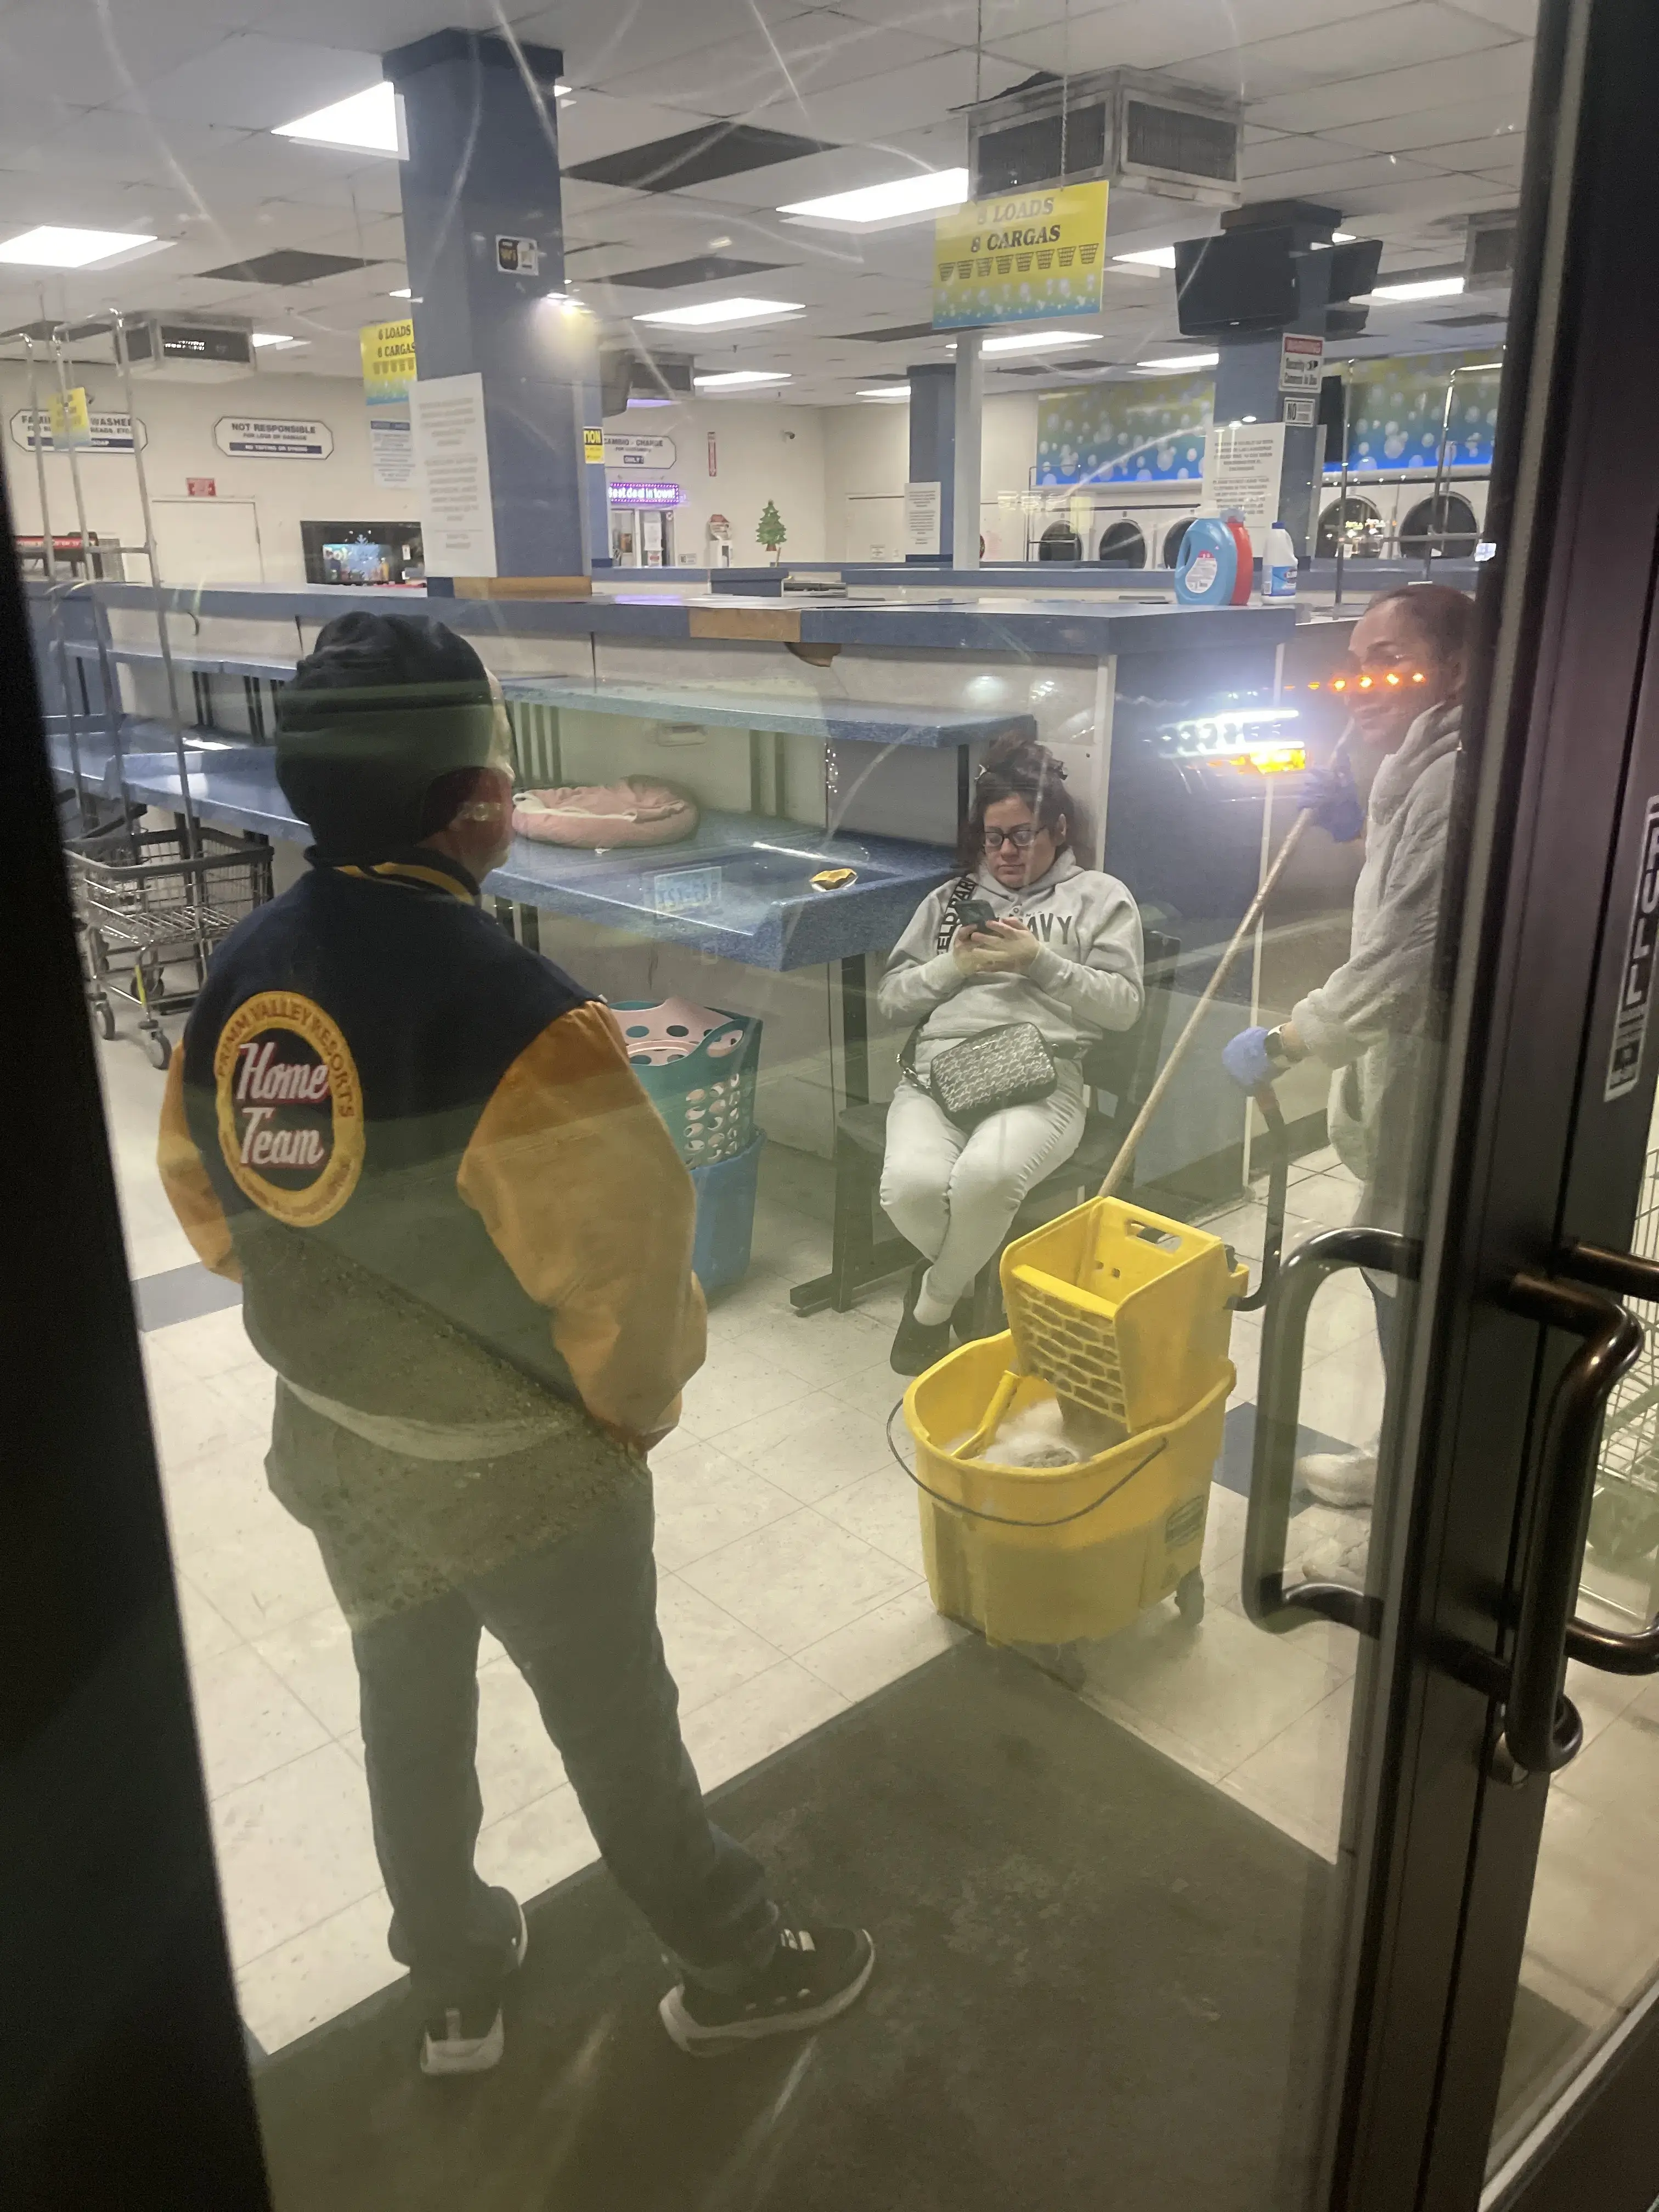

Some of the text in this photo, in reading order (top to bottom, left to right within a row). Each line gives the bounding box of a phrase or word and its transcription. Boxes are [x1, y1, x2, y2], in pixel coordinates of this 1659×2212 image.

[993, 197, 1054, 223] LOADS
[971, 225, 1060, 253] 8 CARGAS
[385, 325, 410, 340] LOADS
[232, 423, 315, 433] NOT RESPONSIBLE
[1019, 912, 1073, 945] AVY
[238, 1042, 329, 1100] Home
[249, 998, 312, 1025] VALLEY
[311, 1018, 354, 1118] RESORTS
[240, 1106, 325, 1165] Team
